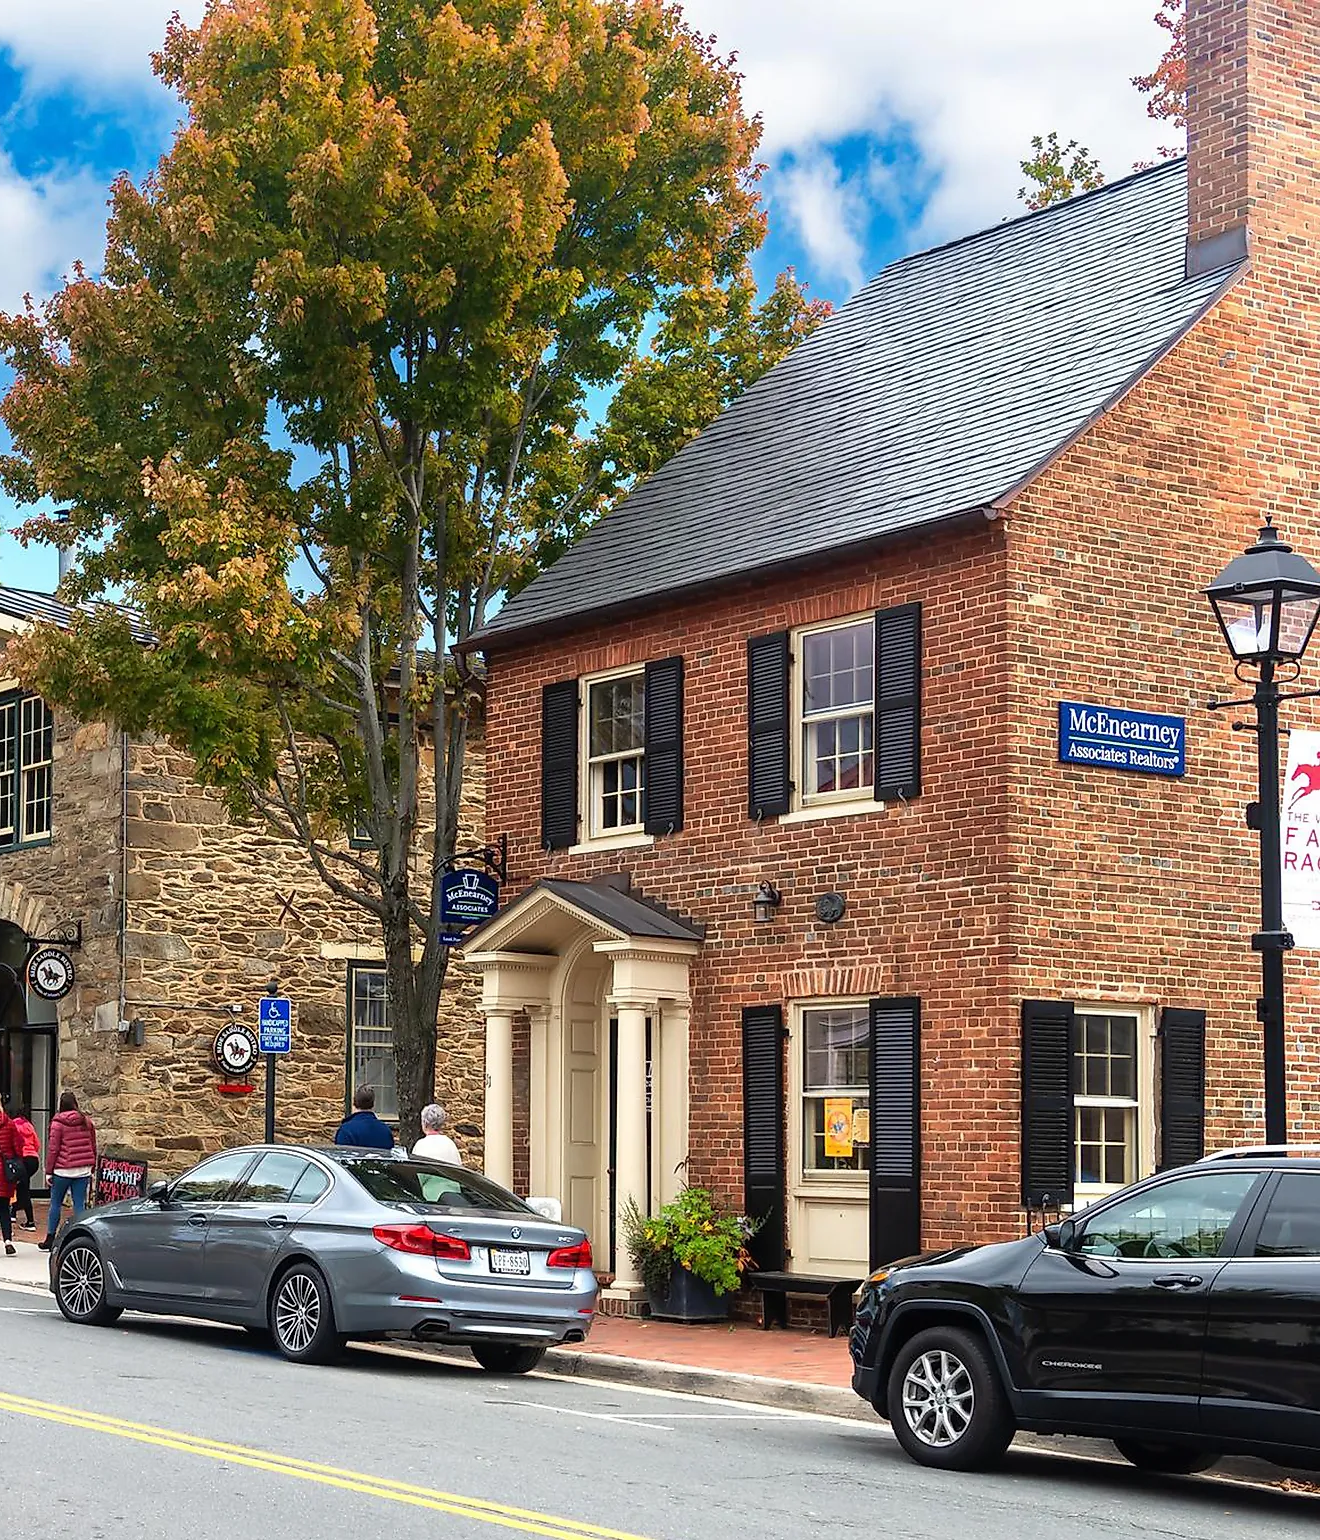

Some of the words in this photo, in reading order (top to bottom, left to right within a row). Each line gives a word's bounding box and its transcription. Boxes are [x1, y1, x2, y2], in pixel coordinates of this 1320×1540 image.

[1069, 707, 1181, 749] McEnearney
[1068, 741, 1127, 764] Associates
[1287, 811, 1310, 823] THE
[1284, 851, 1320, 872] RA
[446, 889, 495, 906] McEnearney
[451, 904, 489, 913] ASSOCIATES
[1041, 1360, 1103, 1370] CHEROKEE
